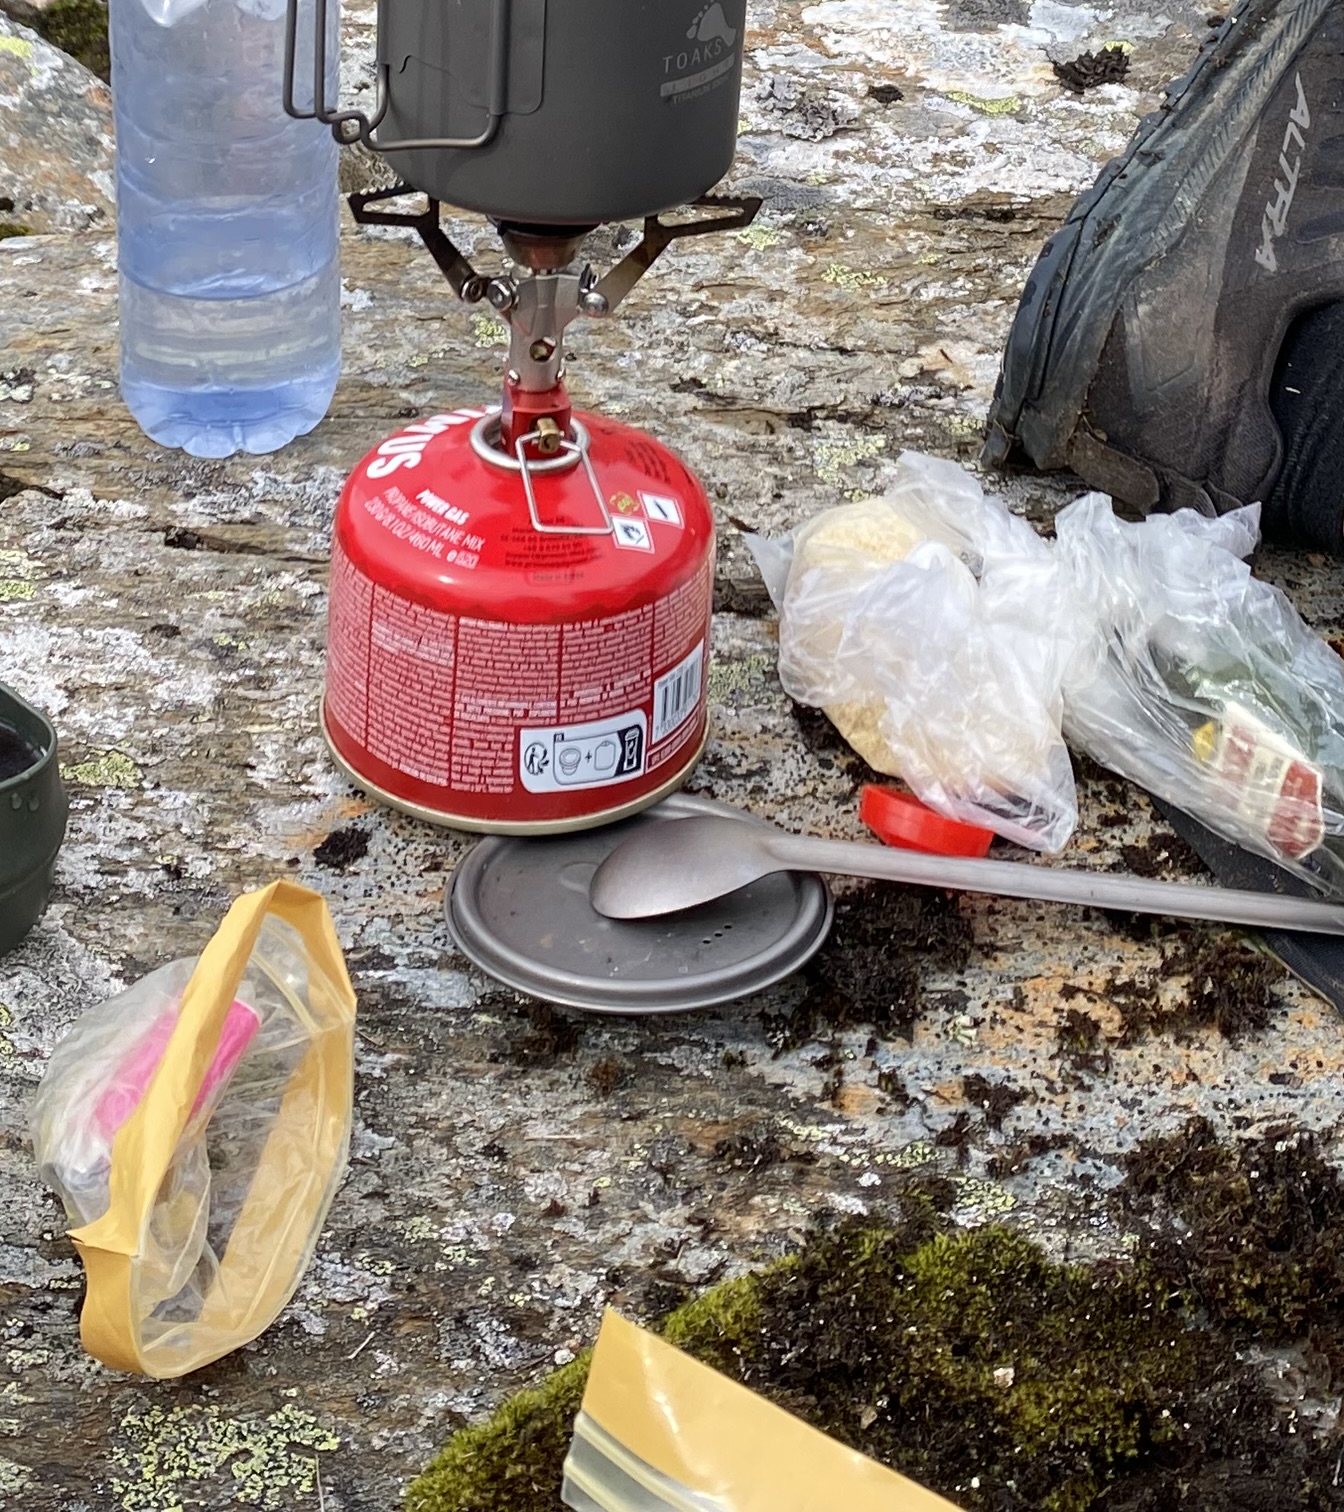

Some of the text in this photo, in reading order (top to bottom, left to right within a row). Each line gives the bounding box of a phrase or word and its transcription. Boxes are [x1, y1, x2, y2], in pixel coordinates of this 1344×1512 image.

[662, 38, 722, 73] TOAKS
[1255, 71, 1311, 273] ALTRA
[366, 404, 503, 479] IMUS
[416, 489, 470, 525] POWER GAS
[460, 533, 486, 552] MIX
